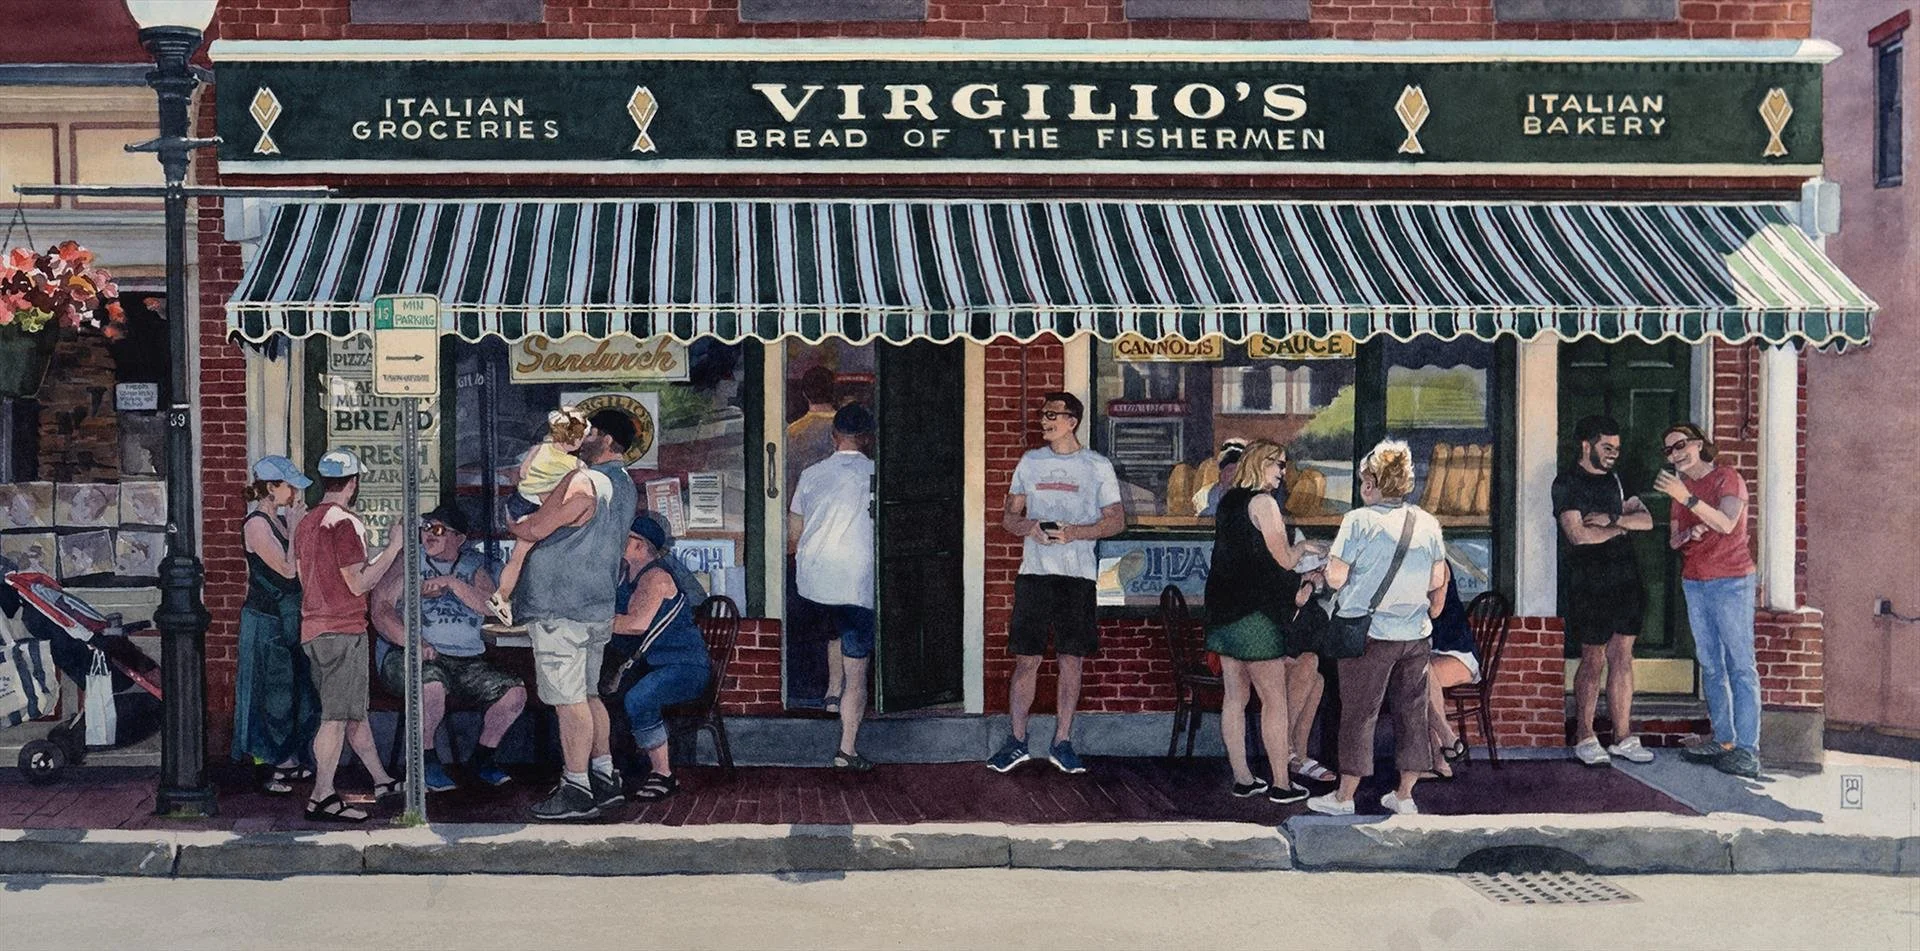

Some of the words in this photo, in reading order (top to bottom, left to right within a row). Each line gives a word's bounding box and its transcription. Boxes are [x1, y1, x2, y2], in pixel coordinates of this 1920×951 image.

[386, 98, 524, 118] ITALIAN
[752, 82, 1308, 123] VIRGILIO'S
[1528, 94, 1664, 114] ITALIAN
[352, 119, 560, 140] GROCERIES
[1523, 115, 1667, 135] BAKERY
[736, 128, 868, 148] BREAD
[903, 128, 952, 148] OF
[989, 128, 1059, 149] THE
[1097, 128, 1326, 151] FISHERMEN
[378, 307, 389, 320] 15
[403, 300, 424, 311] MIN
[395, 314, 435, 326] PARKING
[516, 334, 677, 373] Sandwich
[1118, 339, 1213, 355] CANNOLIS
[1261, 335, 1342, 354] SAUCE
[1143, 546, 1211, 581] ITA
